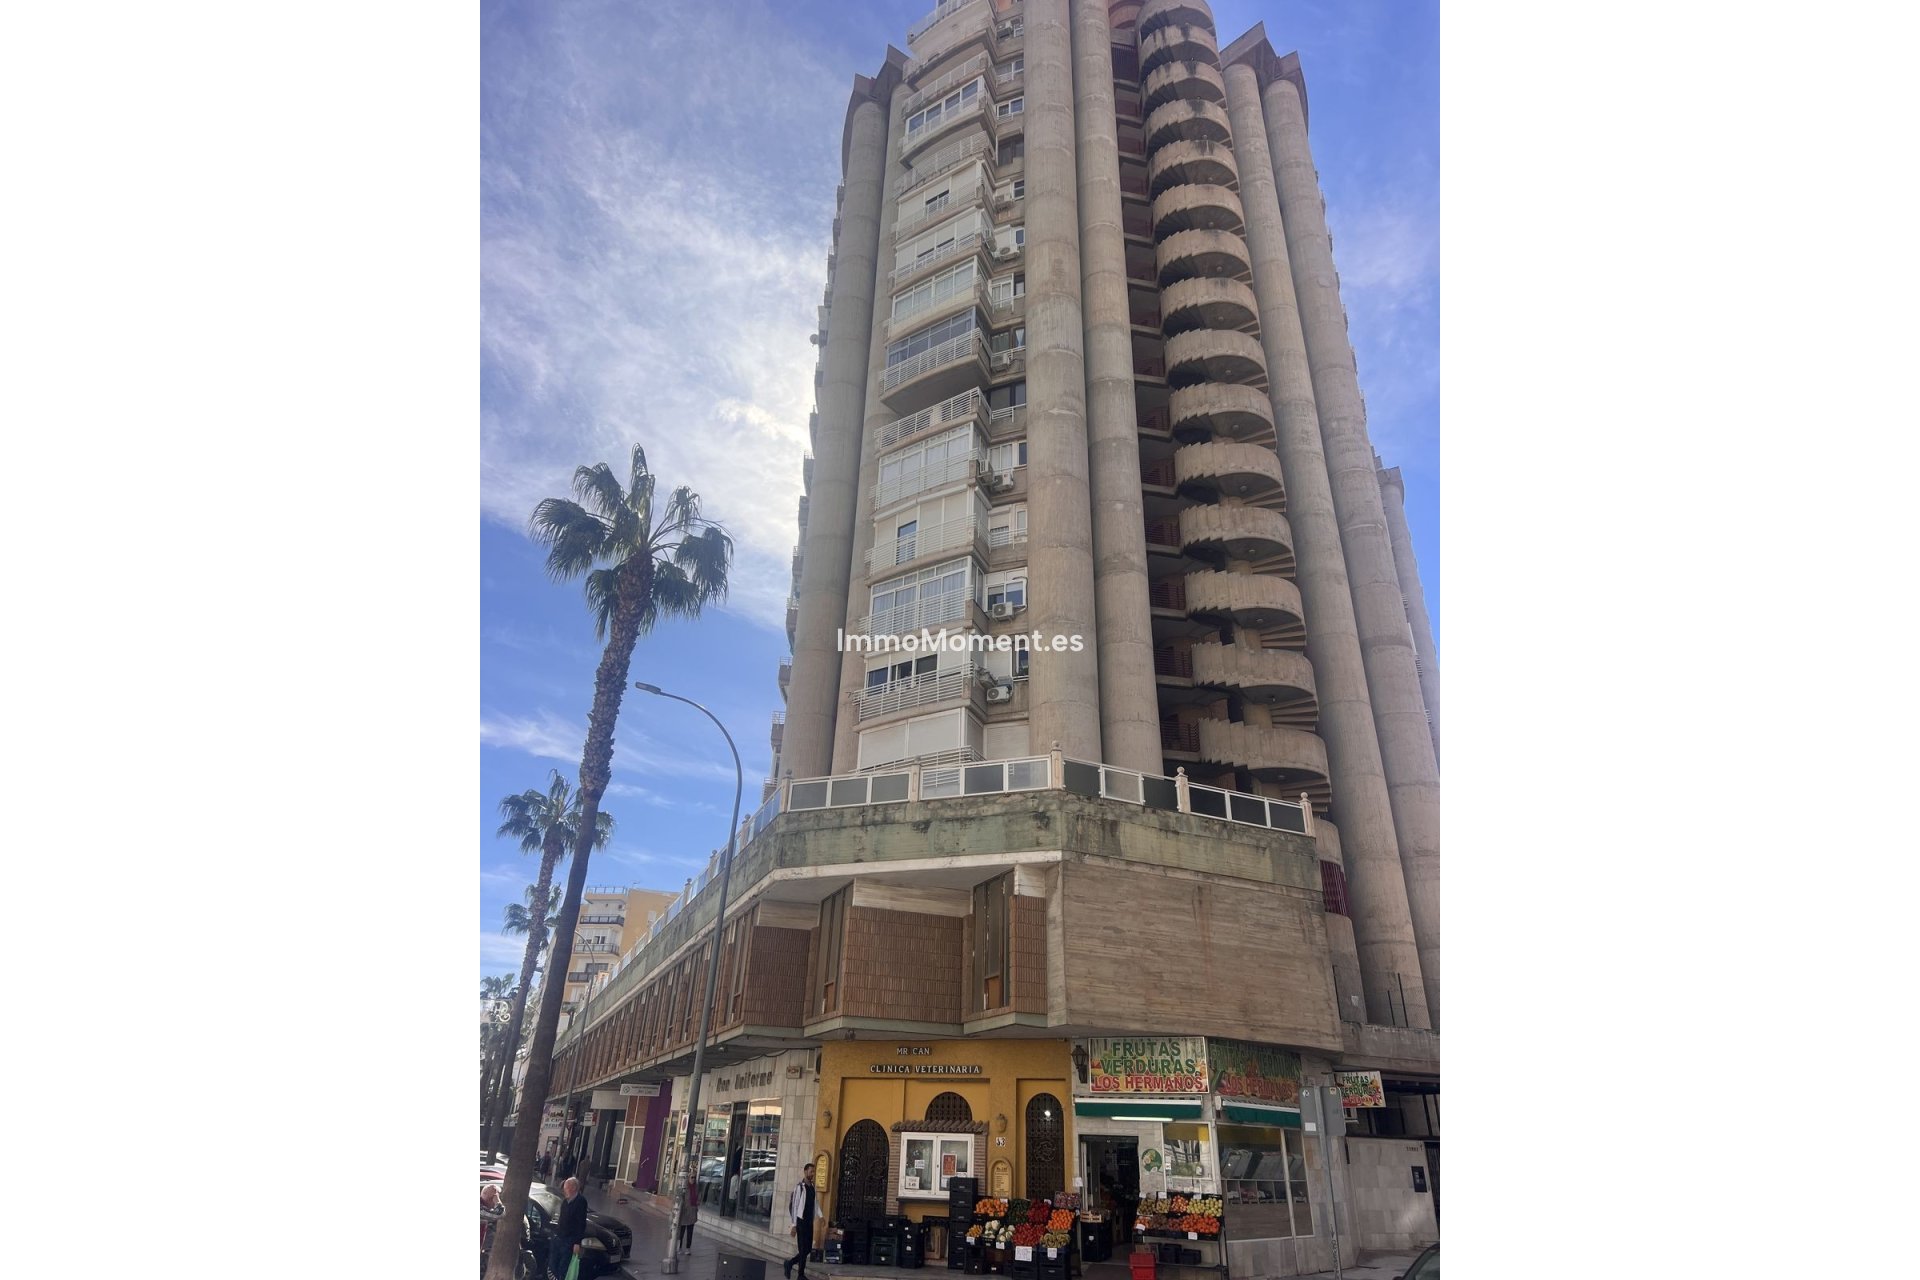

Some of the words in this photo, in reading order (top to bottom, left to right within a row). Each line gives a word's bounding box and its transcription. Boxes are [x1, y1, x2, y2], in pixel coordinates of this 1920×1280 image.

[1112, 1042, 1181, 1056] FRUTAS
[870, 1065, 910, 1073] CLINICA
[915, 1065, 980, 1074] VETERINARIA
[1100, 1059, 1196, 1074] VERDURAS
[716, 1077, 730, 1093] Don
[734, 1071, 773, 1090] Uniforme
[1093, 1076, 1120, 1089] LOS
[1125, 1076, 1203, 1090] HERMANOS
[1342, 1075, 1370, 1084] FRUTAS
